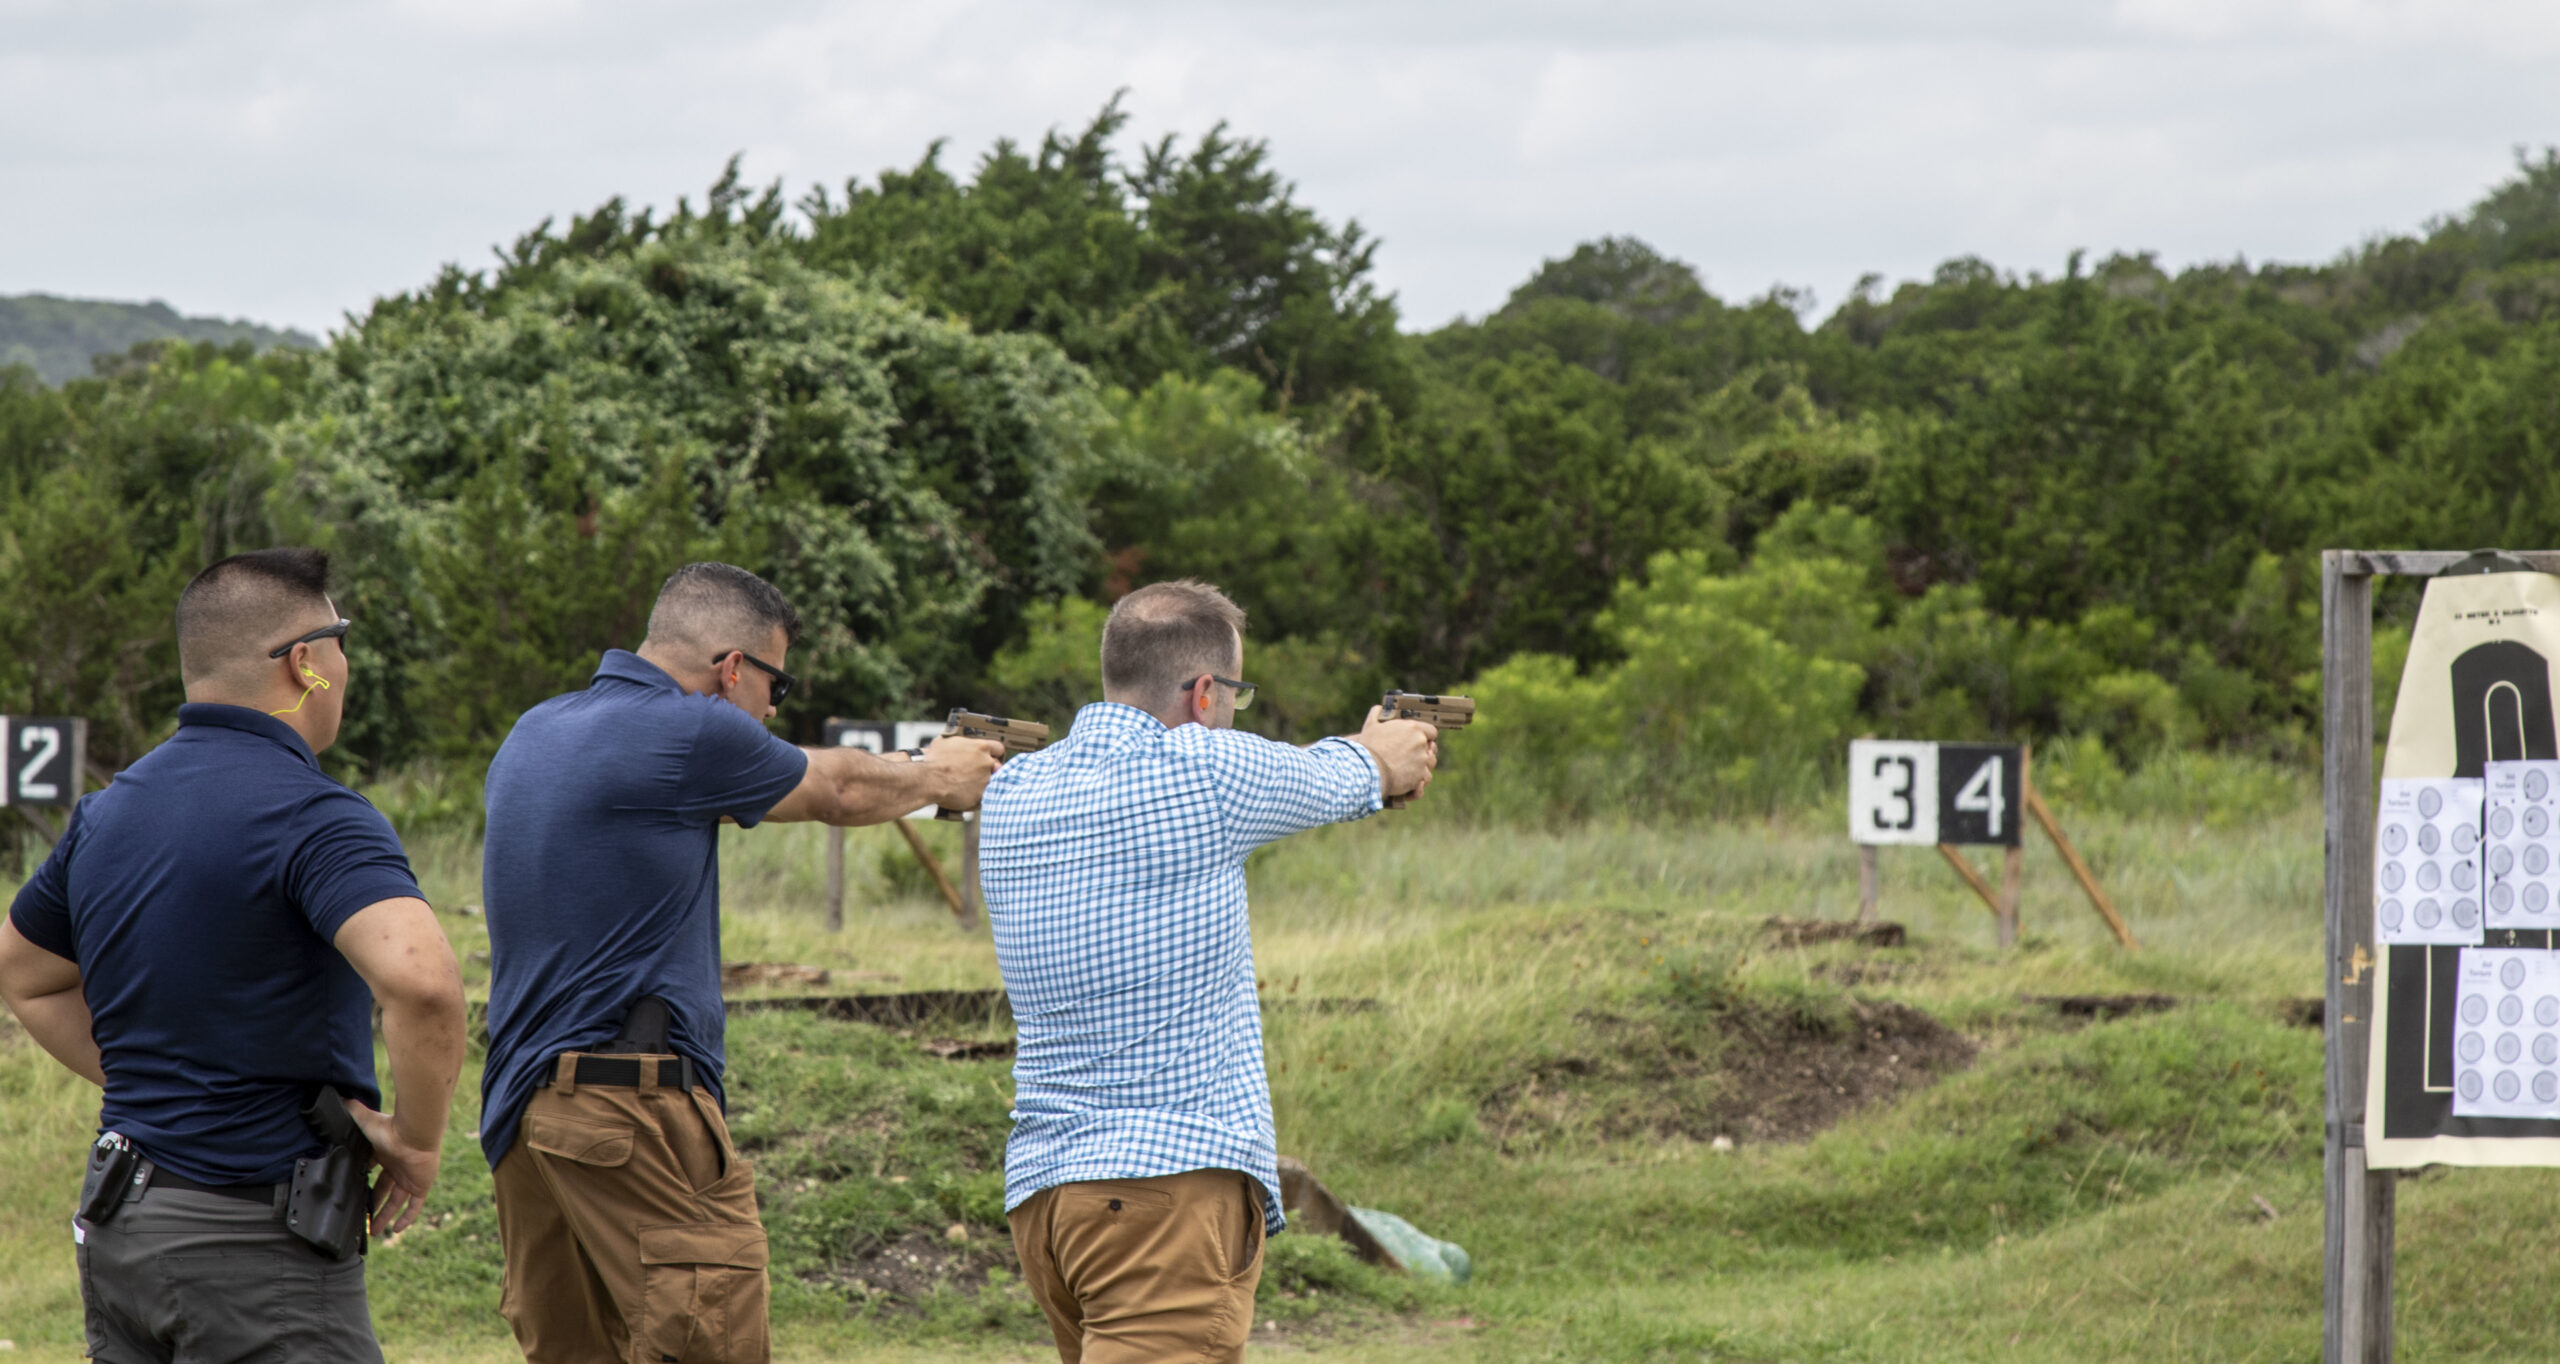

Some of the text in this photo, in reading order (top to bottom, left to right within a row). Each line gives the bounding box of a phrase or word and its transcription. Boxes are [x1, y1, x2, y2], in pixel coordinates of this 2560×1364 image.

[19, 727, 60, 799] 2
[1873, 755, 2005, 837] 3 4
